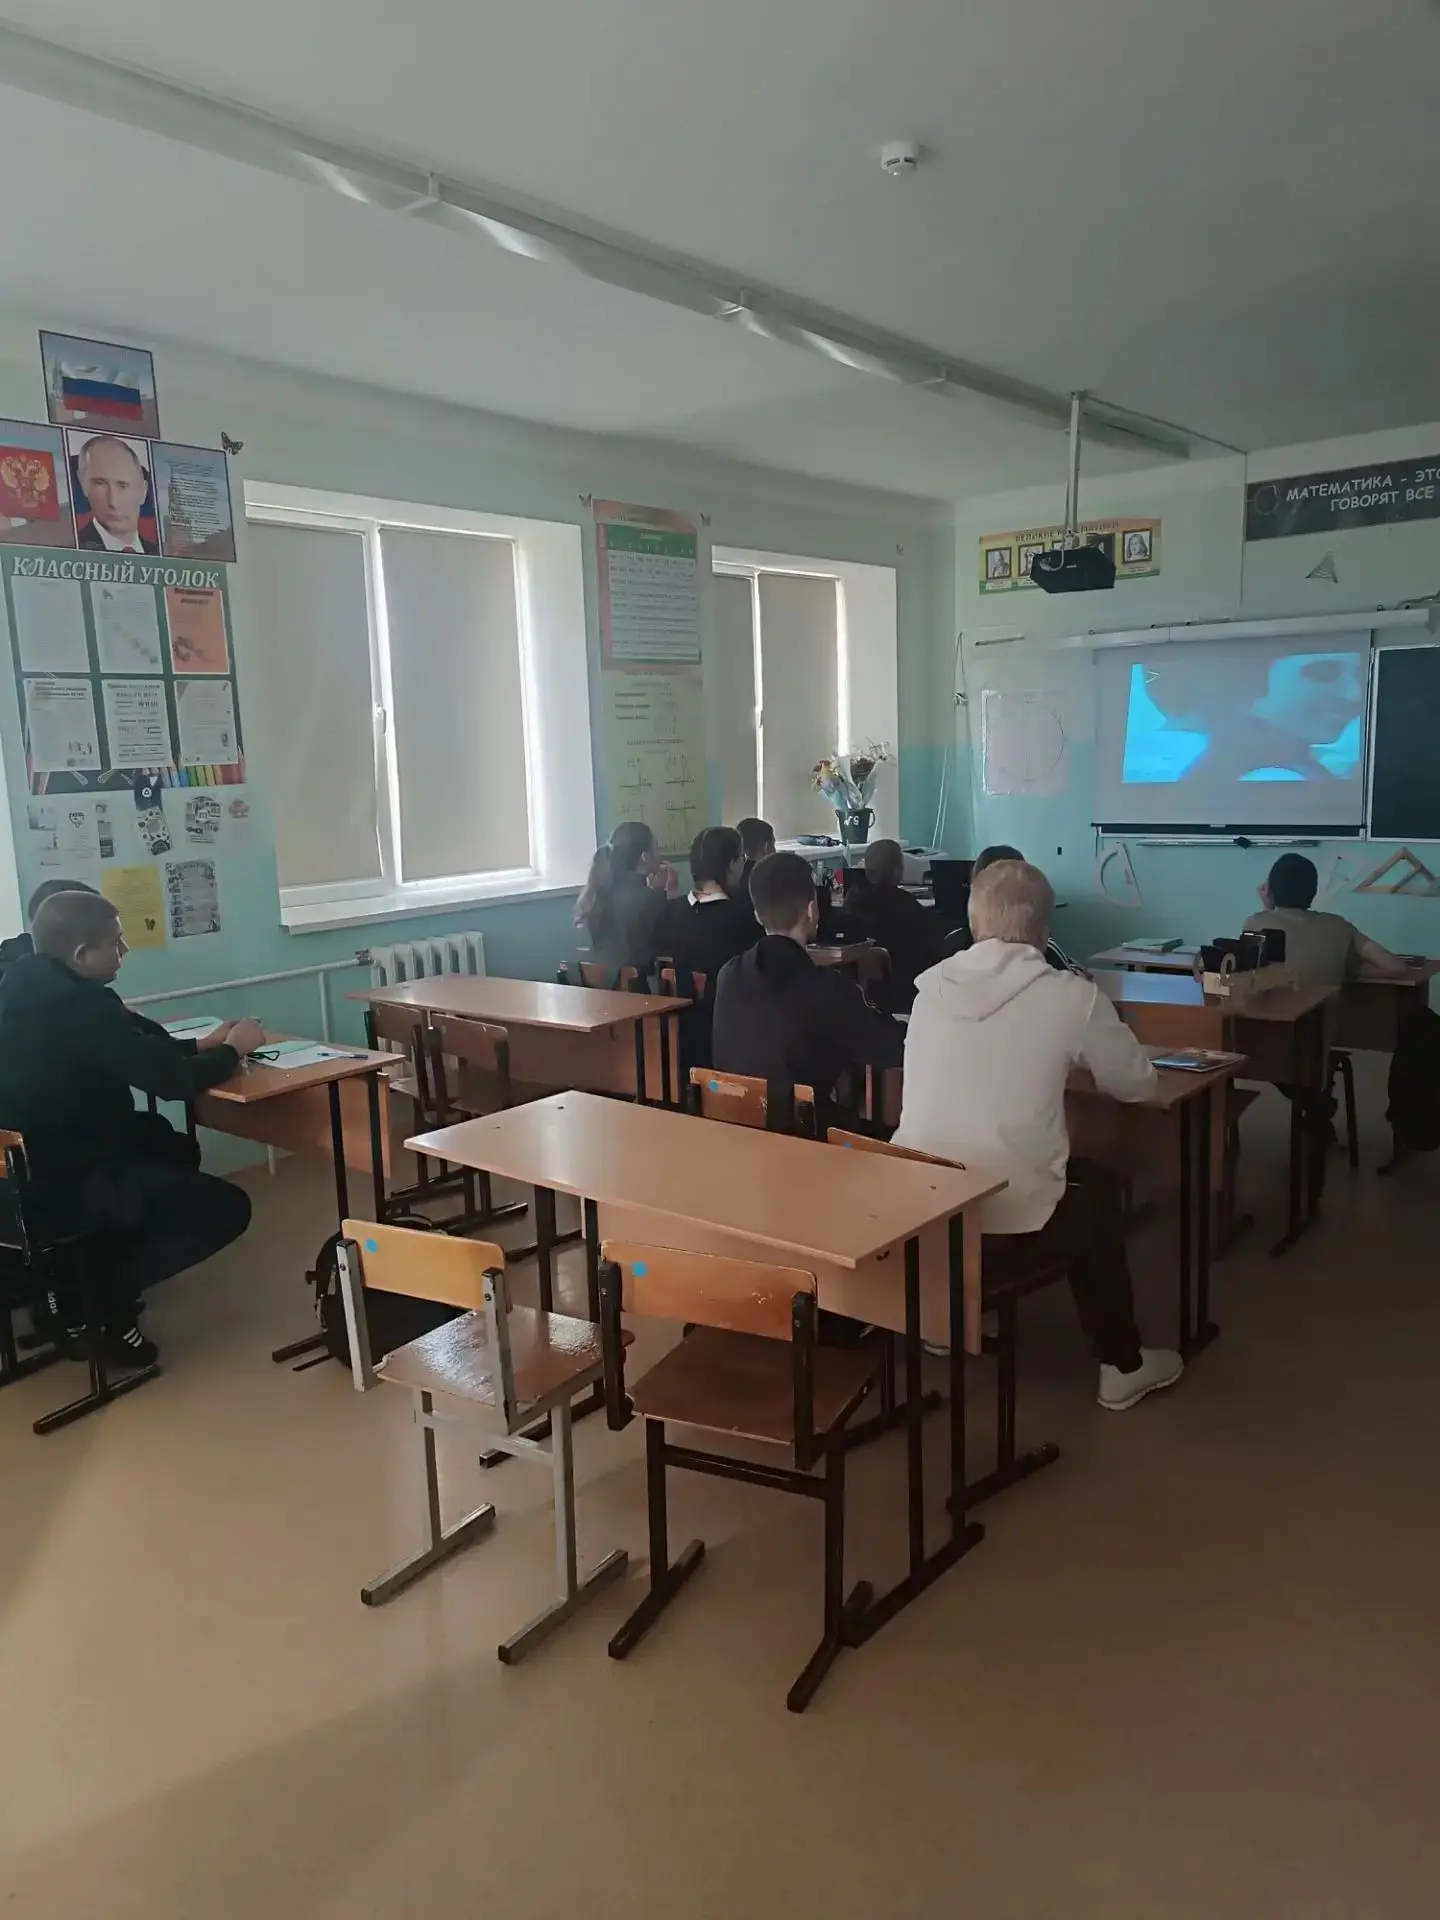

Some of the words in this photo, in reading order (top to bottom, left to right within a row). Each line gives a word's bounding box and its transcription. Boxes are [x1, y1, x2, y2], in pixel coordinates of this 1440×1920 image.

[1286, 475, 1393, 501] МАТЕМАТИКА
[1330, 491, 1400, 512] ГОВОРЯТ
[1406, 485, 1435, 501] ВСЕ
[12, 556, 135, 583] КЛАССНЫЙ
[139, 566, 219, 589] УГОЛОК
